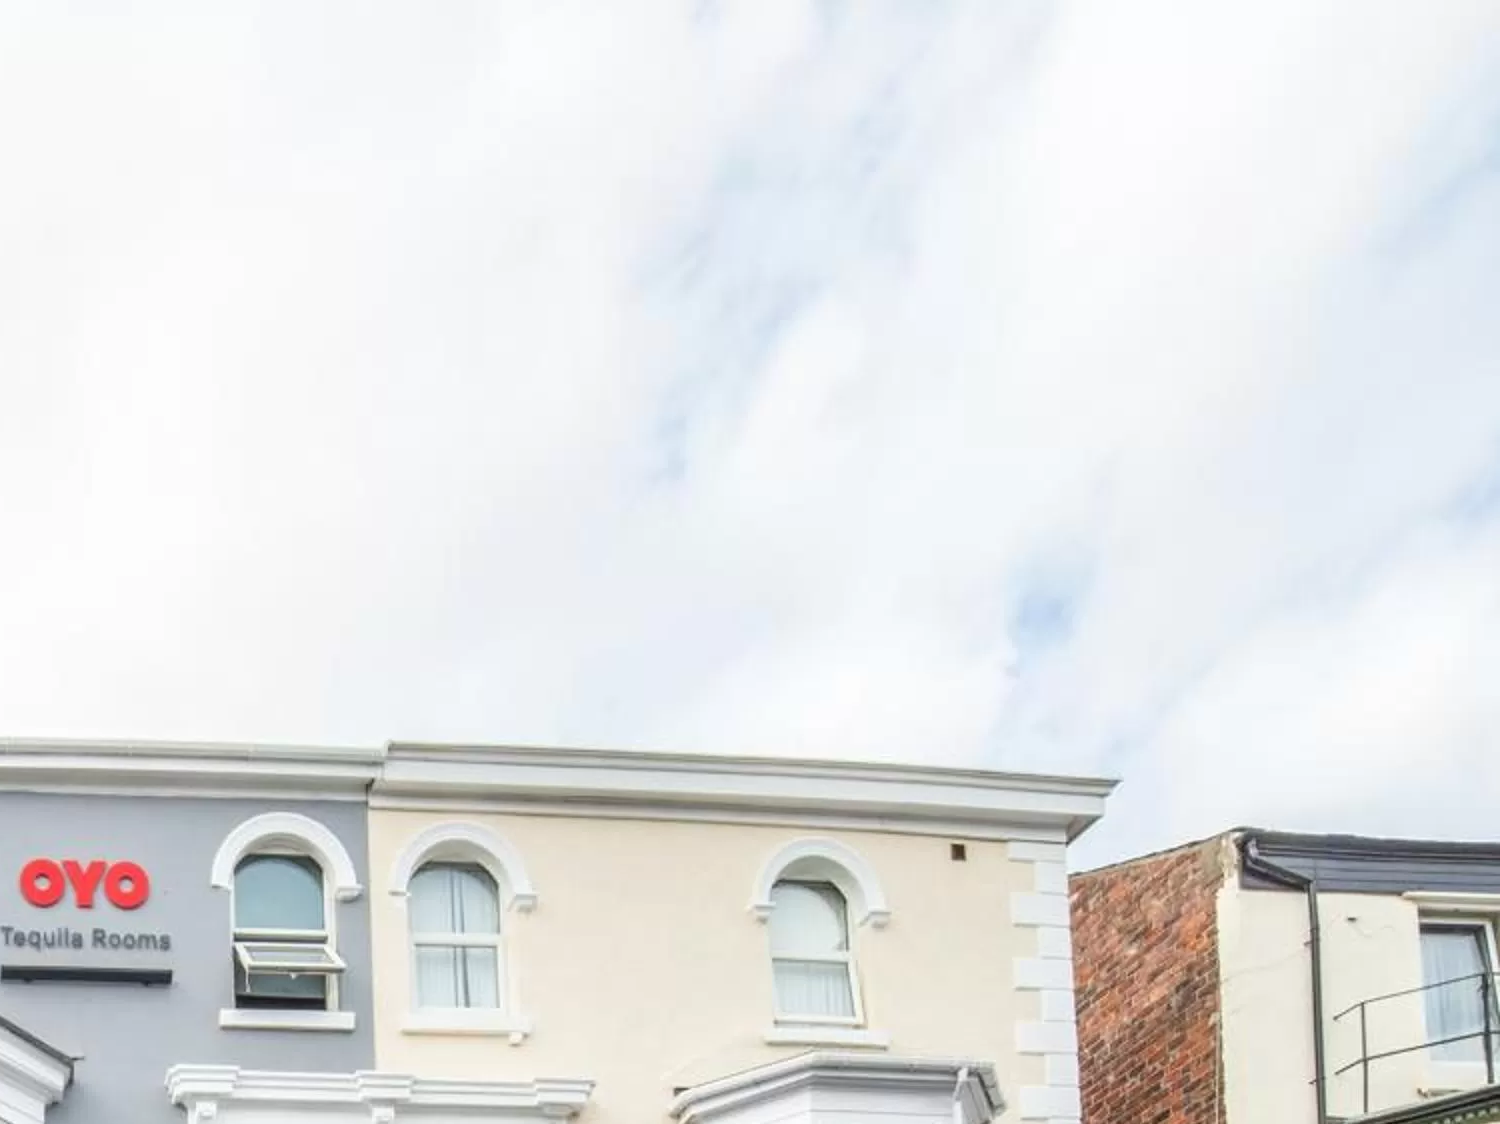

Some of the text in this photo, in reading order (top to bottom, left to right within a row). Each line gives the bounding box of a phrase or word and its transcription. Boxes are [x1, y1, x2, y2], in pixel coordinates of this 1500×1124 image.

[19, 858, 150, 910] OYO
[0, 926, 172, 951] Tequila Rooms
